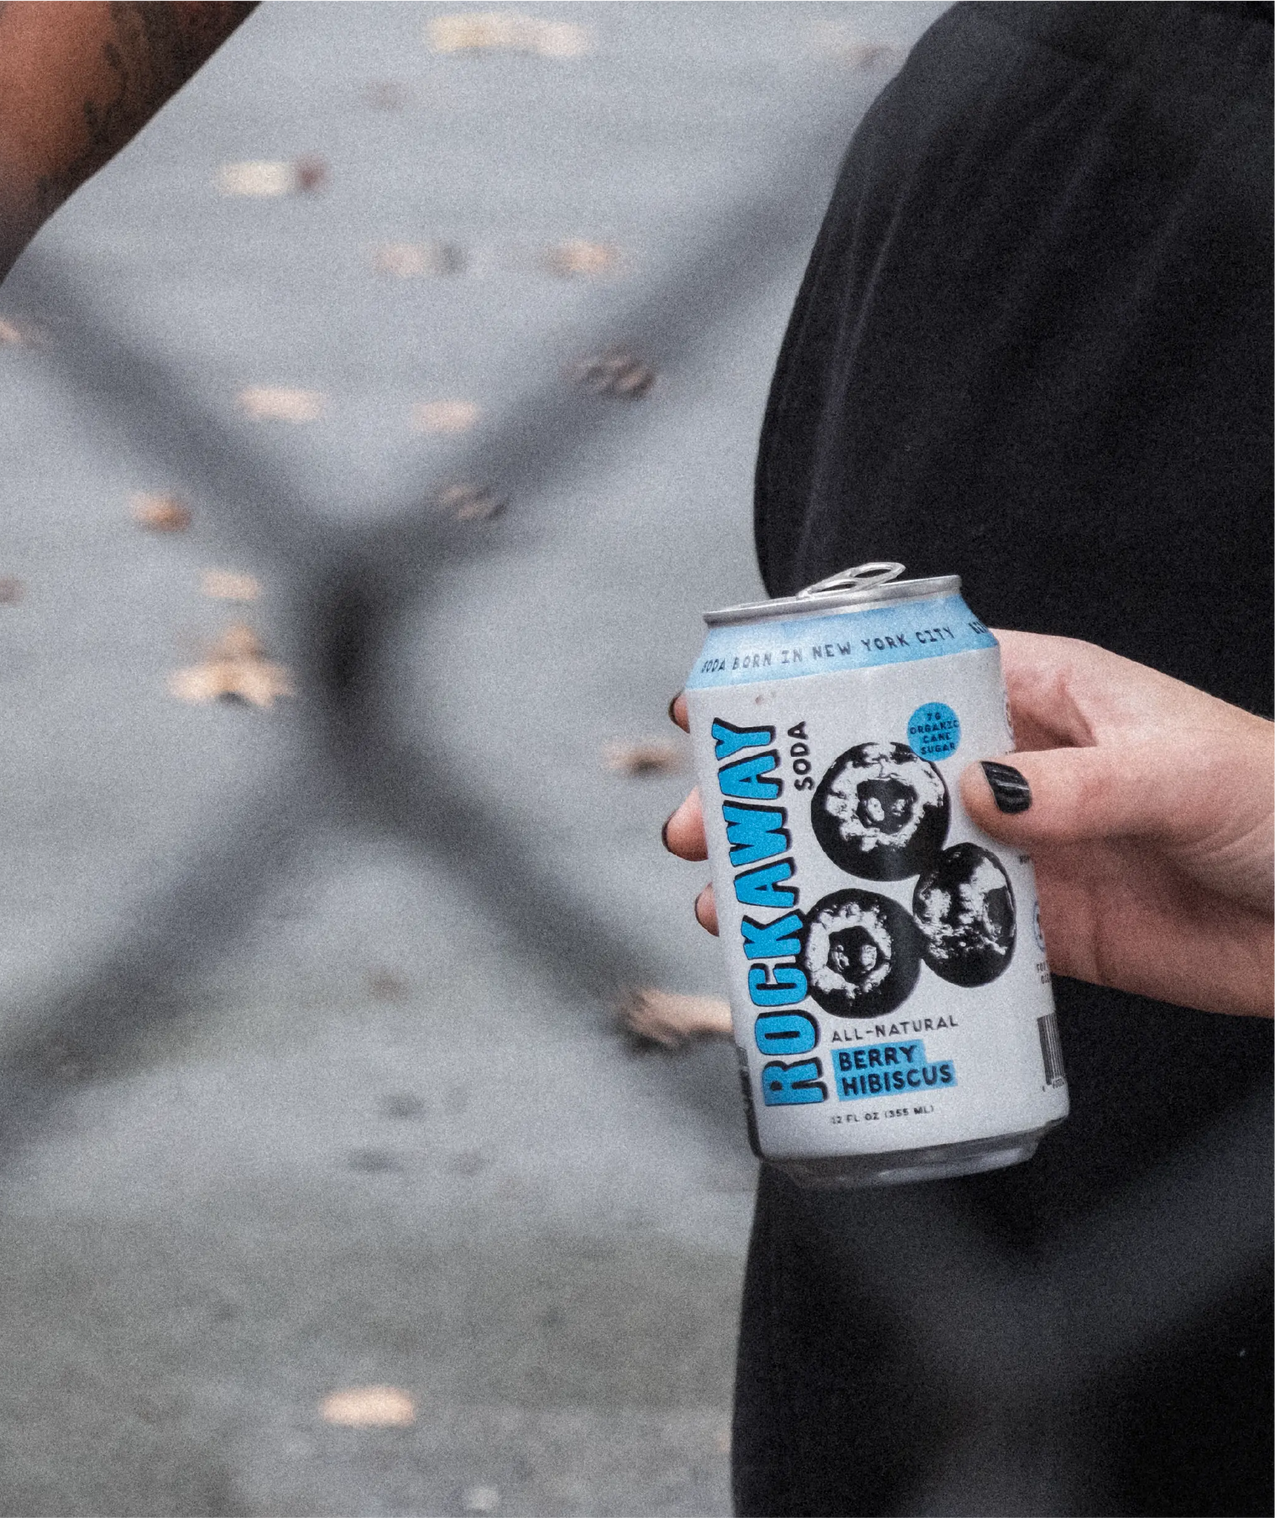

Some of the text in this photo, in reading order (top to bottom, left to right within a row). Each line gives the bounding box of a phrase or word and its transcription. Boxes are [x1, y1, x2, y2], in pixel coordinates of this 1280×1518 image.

[700, 658, 727, 675] SODA
[731, 652, 773, 671] BORN
[780, 649, 803, 664] IN
[812, 641, 852, 659] NEW
[861, 634, 910, 651] YORK
[915, 625, 956, 644] CITY
[910, 719, 960, 735] ORGANIC
[923, 732, 952, 744] CANE
[793, 720, 814, 791] SODA
[921, 742, 956, 755] SUGAR
[711, 716, 828, 1108] ROCKAWAY
[831, 1014, 959, 1043] ALL-NATURAL
[838, 1044, 918, 1072] BERRY
[841, 1064, 954, 1097] HIBISCUS
[831, 1105, 935, 1125] 12 FL OZ (355 ML)
